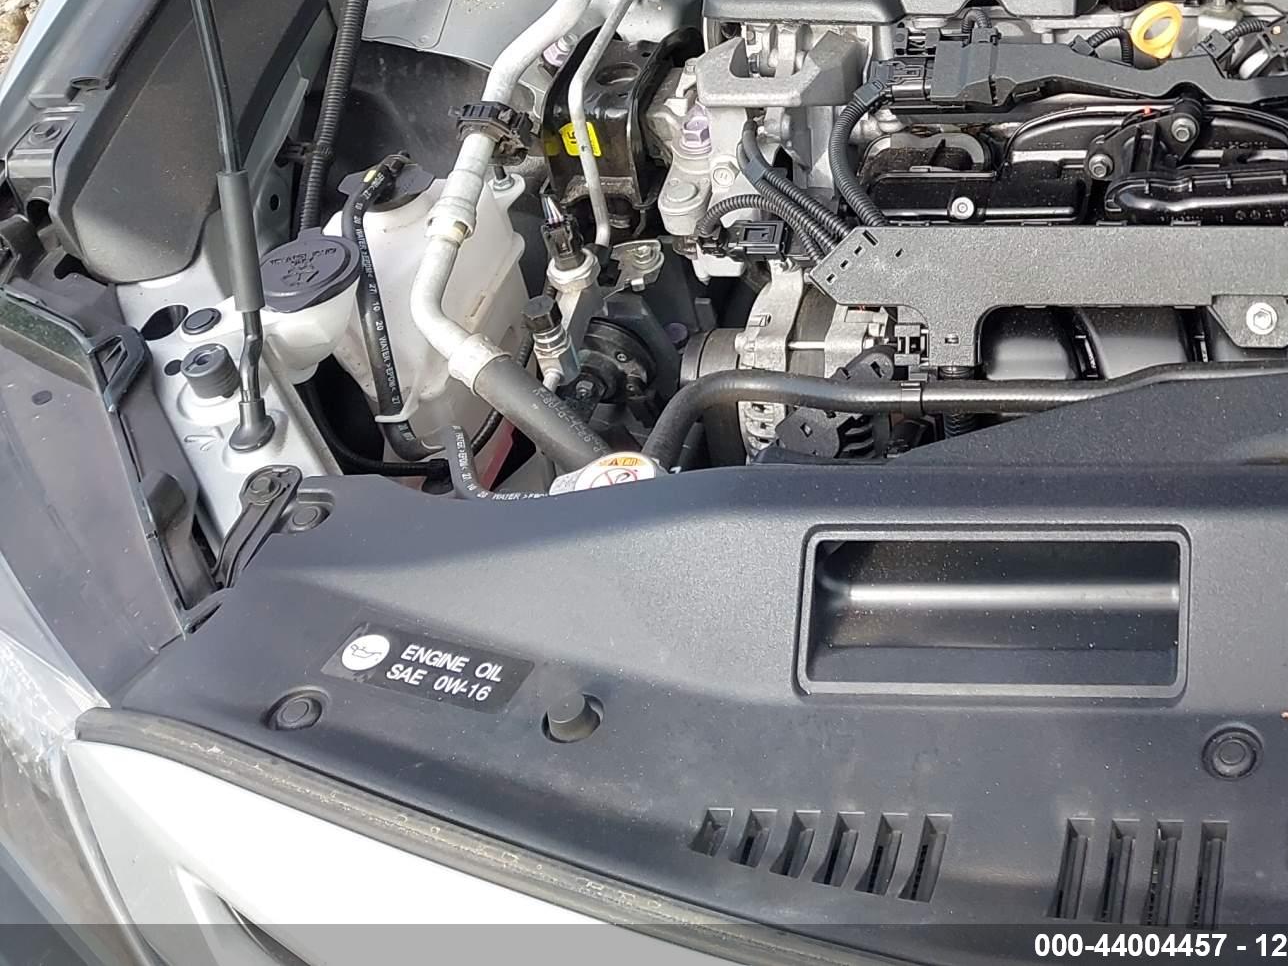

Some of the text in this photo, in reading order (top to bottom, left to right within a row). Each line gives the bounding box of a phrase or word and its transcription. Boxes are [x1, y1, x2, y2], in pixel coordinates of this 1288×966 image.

[386, 663, 492, 701] SAE 0W-16
[400, 644, 504, 682] ENGINE OIL
